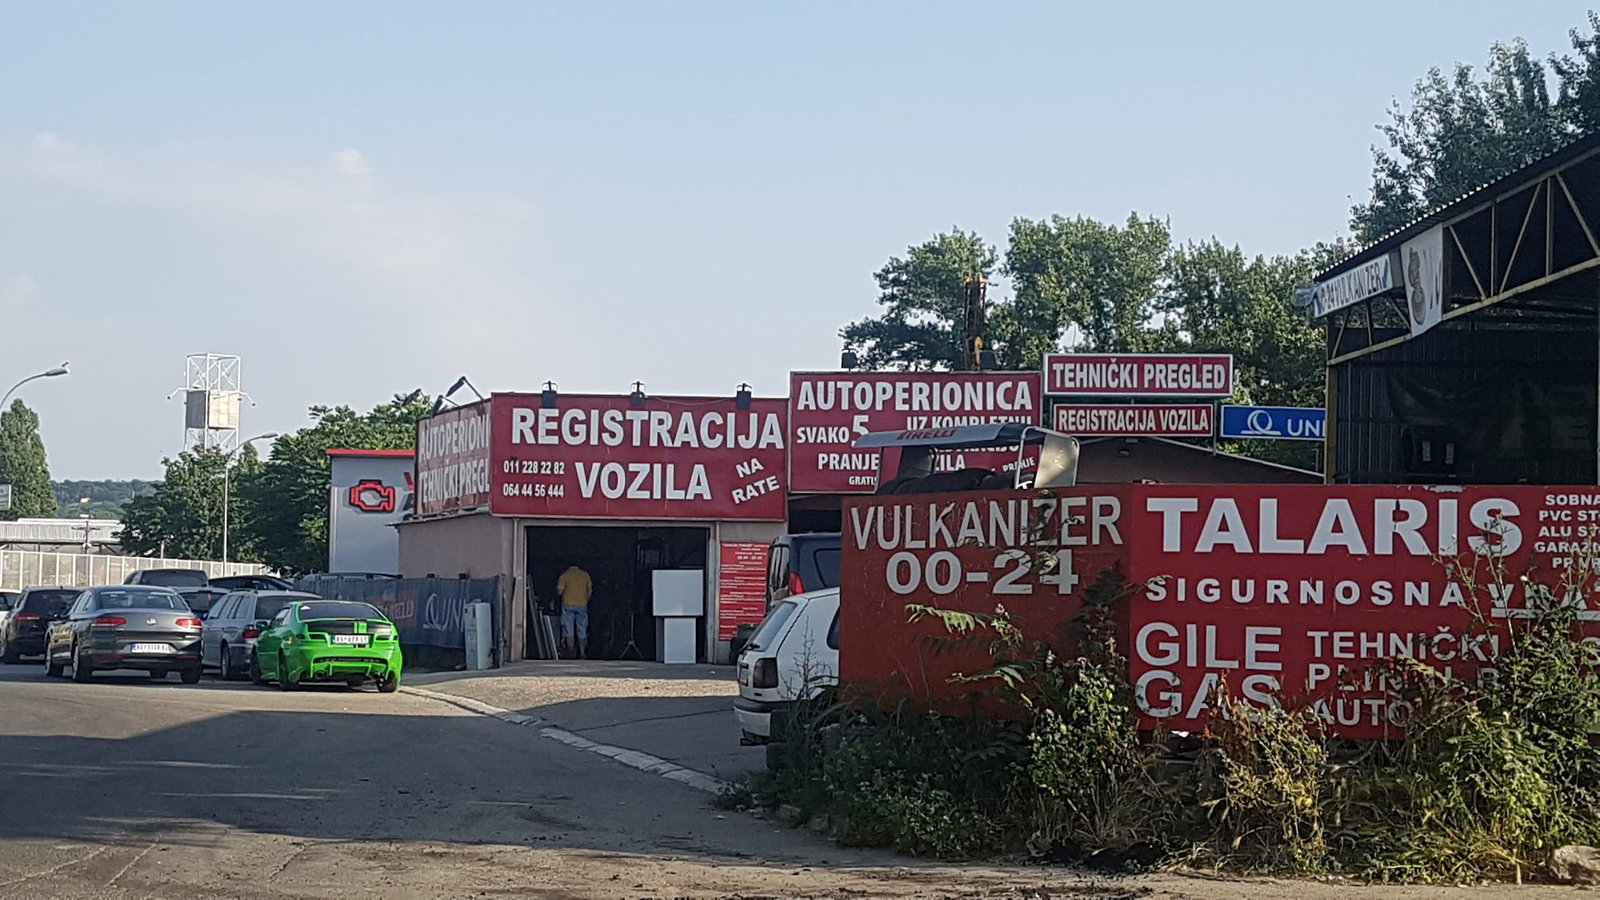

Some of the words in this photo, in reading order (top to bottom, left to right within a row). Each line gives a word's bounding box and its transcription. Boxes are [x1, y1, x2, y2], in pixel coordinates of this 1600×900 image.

[1052, 358, 1138, 388] TEHNIČKI
[1144, 363, 1226, 389] PREGLED
[797, 380, 1033, 411] AUTOPERIONICA
[511, 407, 785, 449] REGISTRACIJA
[796, 426, 850, 444] SVAKO
[1058, 407, 1156, 432] REGISTRACIJA
[1159, 409, 1209, 431] VOZILA
[503, 460, 519, 474] 011
[522, 460, 539, 474] 228
[540, 461, 552, 475] 22
[553, 461, 565, 475] 82
[735, 457, 765, 478] NA
[817, 453, 880, 470] PRANJE
[502, 483, 519, 497] 064
[521, 483, 533, 497] 44
[534, 484, 546, 497] 56
[547, 484, 564, 498] 444
[575, 461, 713, 500] VOZILA
[731, 475, 781, 504] RATE
[850, 495, 1124, 550] VULKANIZER
[1146, 497, 1523, 557] TALARIS
[1538, 510, 1572, 522] PVC
[1577, 510, 1600, 521] ST
[1538, 525, 1572, 537] ALU
[886, 548, 1079, 595] 00-24
[1145, 576, 1467, 607] SIGURNOSNA
[1135, 621, 1283, 671] GILE
[1306, 626, 1498, 661] TEHNIČKI
[1134, 669, 1282, 720] GAS
